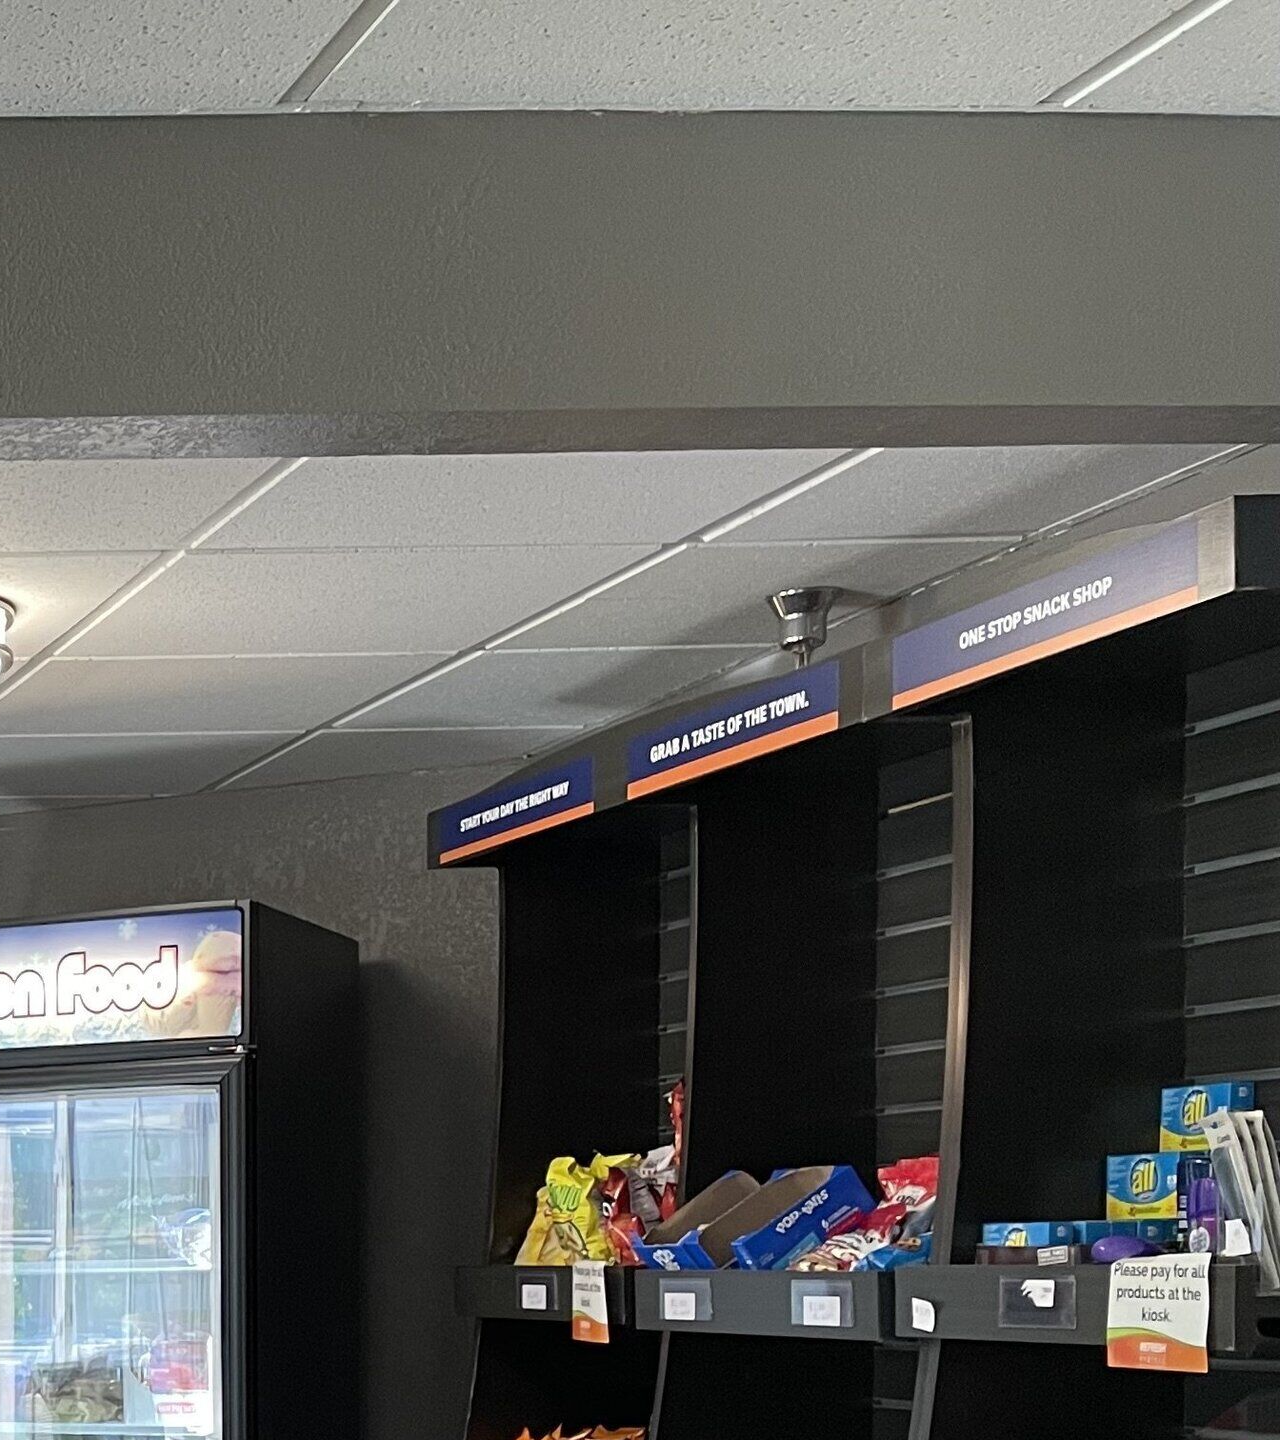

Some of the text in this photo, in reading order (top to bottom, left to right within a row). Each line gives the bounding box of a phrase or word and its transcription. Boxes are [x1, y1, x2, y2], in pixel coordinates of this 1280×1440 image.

[959, 576, 1112, 649] ONE STOP SNACK SHOP
[650, 690, 809, 763] GRAB A TASTE OF THE TOWN.
[460, 781, 569, 832] START YOUR DAY THE RIGHT WAY
[1184, 1092, 1206, 1126] all
[1131, 1161, 1156, 1194] all
[1114, 1264, 1205, 1281] Please pay for all
[1117, 1286, 1201, 1301] products at the
